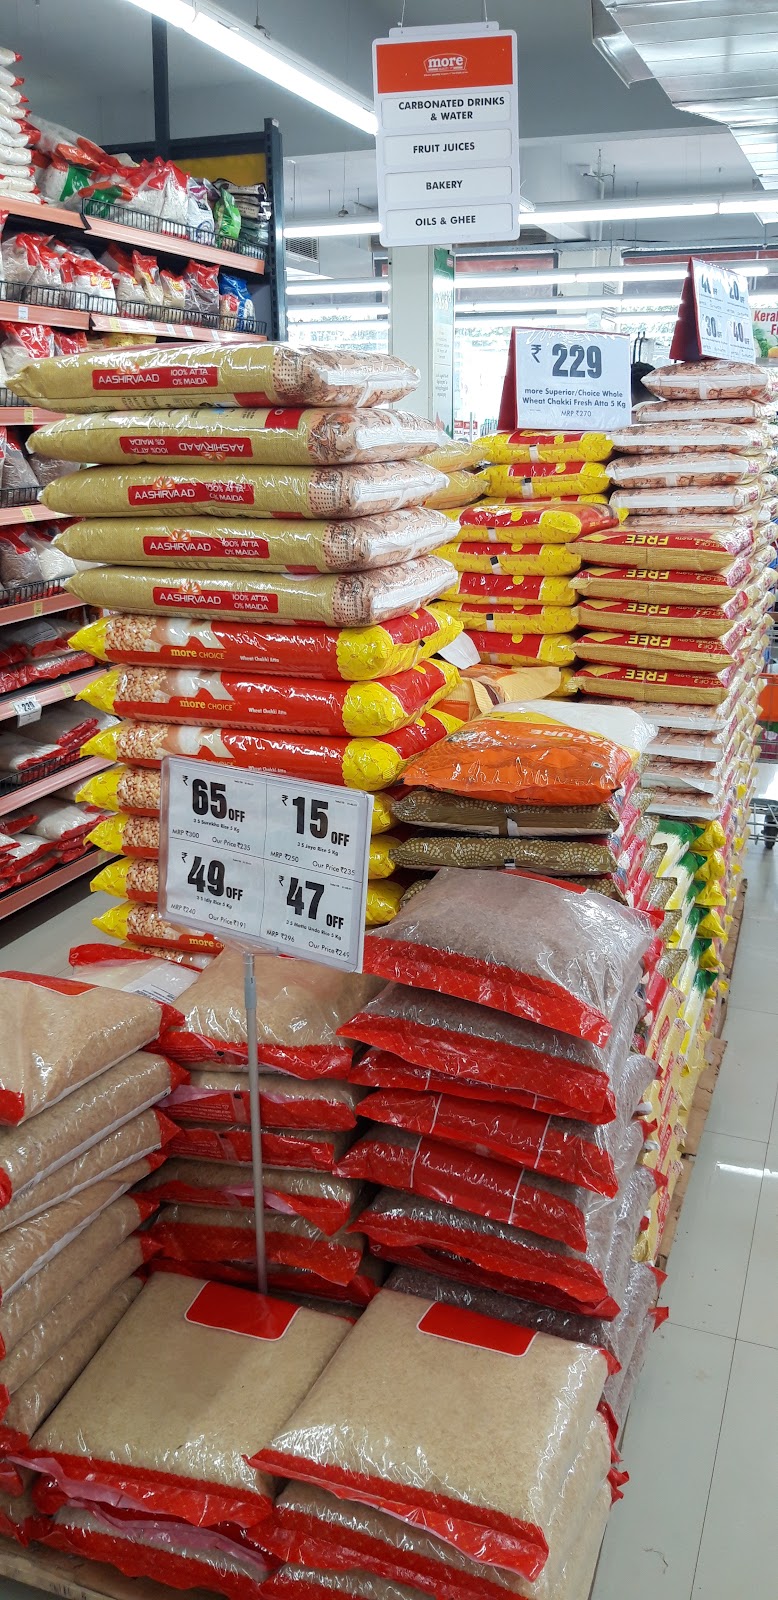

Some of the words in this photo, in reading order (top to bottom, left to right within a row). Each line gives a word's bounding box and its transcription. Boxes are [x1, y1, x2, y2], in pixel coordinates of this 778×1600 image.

[428, 56, 464, 68] more
[399, 99, 465, 110] CARBONATED
[467, 97, 505, 107] DRINKS
[430, 113, 438, 121] &
[440, 111, 473, 120] WATER
[413, 144, 440, 154] FRUIT
[443, 142, 475, 152] JUICES
[426, 180, 463, 190] BAKERY
[415, 218, 437, 226] OILS
[440, 217, 447, 225] &
[450, 215, 476, 225] GHEE
[733, 321, 744, 343] 40
[552, 343, 602, 379] 229
[189, 368, 208, 376] ATTA
[99, 373, 160, 385] AASHIRVAAD
[183, 377, 208, 385] MAIDA
[545, 388, 600, 397] Superior/Choice
[602, 390, 623, 398] Whole
[547, 397, 571, 405] Chakki
[574, 398, 592, 407] Fresh
[594, 399, 608, 407] Atta
[617, 400, 626, 408] Kg
[178, 442, 244, 453] AASHIRVAAD
[134, 489, 196, 500] AASHIRVAAD
[220, 494, 244, 502] MAIDA
[221, 539, 239, 547] 100%
[241, 539, 259, 547] ATTA
[625, 534, 669, 546] FREE
[150, 542, 211, 553] AASHIRVAAD
[626, 569, 670, 580] FREE
[160, 592, 221, 604] AASHIRVAAD
[232, 593, 249, 601] 100%
[250, 594, 269, 602] ATTA
[627, 603, 670, 615] FREE
[628, 635, 672, 647] FREE
[171, 648, 197, 657] more
[199, 651, 225, 660] CHOICE
[625, 669, 668, 682] FREE
[180, 699, 206, 708] more
[208, 703, 233, 711] CHOICE
[192, 778, 227, 820] 65
[228, 808, 245, 822] OFF
[292, 796, 329, 839] 15
[331, 831, 350, 847] OFF
[172, 828, 185, 836] MRP
[211, 836, 222, 844] Our
[224, 839, 236, 848] Price
[237, 842, 250, 851] ₹235
[270, 850, 282, 858] MRP
[304, 843, 316, 851] Jaya
[332, 849, 339, 857] Kg
[312, 860, 324, 868] Our
[326, 863, 339, 873] Price
[340, 866, 355, 876] ₹235
[187, 856, 225, 897] 49
[226, 886, 243, 901] OFF
[170, 903, 183, 911] MRP
[286, 876, 325, 920] 47
[326, 913, 344, 930] OFF
[208, 913, 219, 921] Our
[220, 916, 233, 925] Price
[233, 920, 246, 929] ₹191
[321, 929, 330, 937] Rice
[334, 933, 342, 941] Kg
[189, 938, 214, 947] more
[308, 940, 320, 949] Our
[321, 944, 335, 954] Price
[335, 948, 350, 959] ₹249
